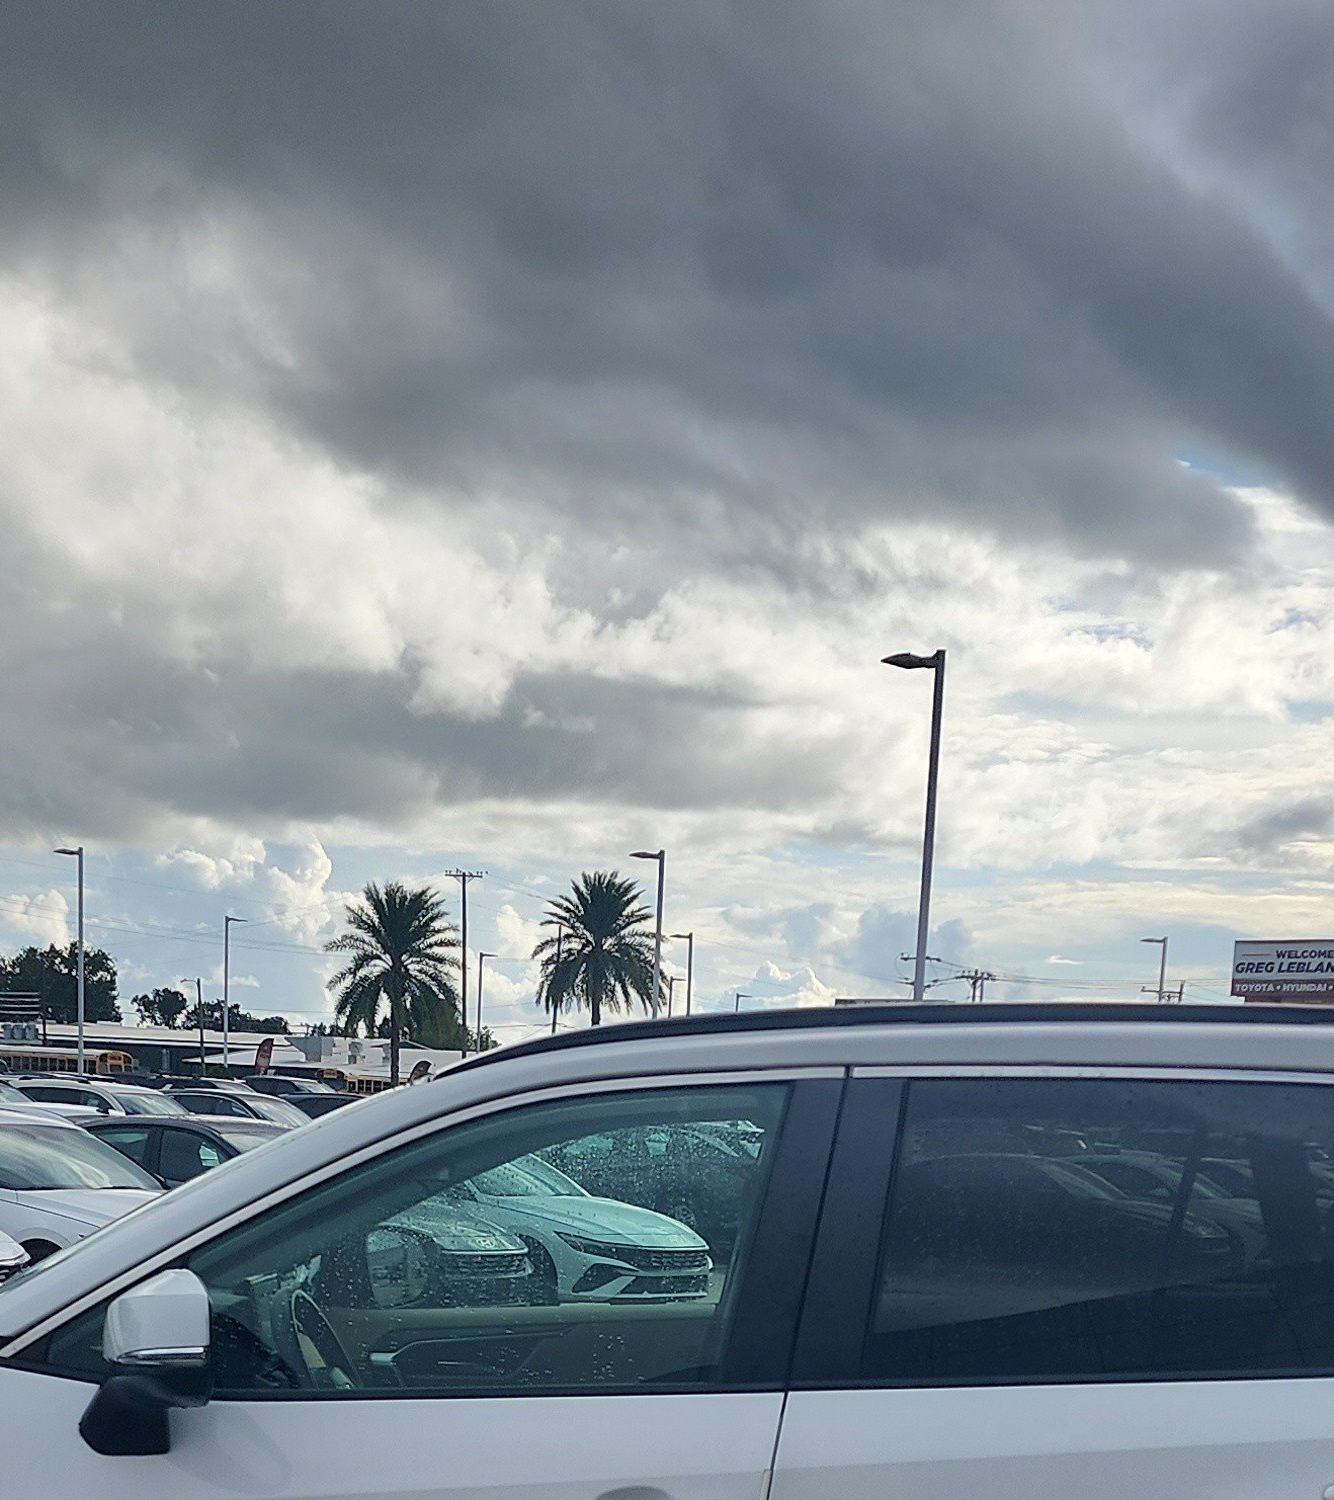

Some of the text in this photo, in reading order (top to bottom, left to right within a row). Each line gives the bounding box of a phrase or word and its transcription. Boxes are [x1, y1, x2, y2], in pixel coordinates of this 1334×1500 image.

[1276, 950, 1334, 959] WELCOME
[1235, 962, 1274, 974] GREG
[1235, 983, 1275, 992] TOYOTA
[1283, 983, 1327, 992] HYUNDAI
